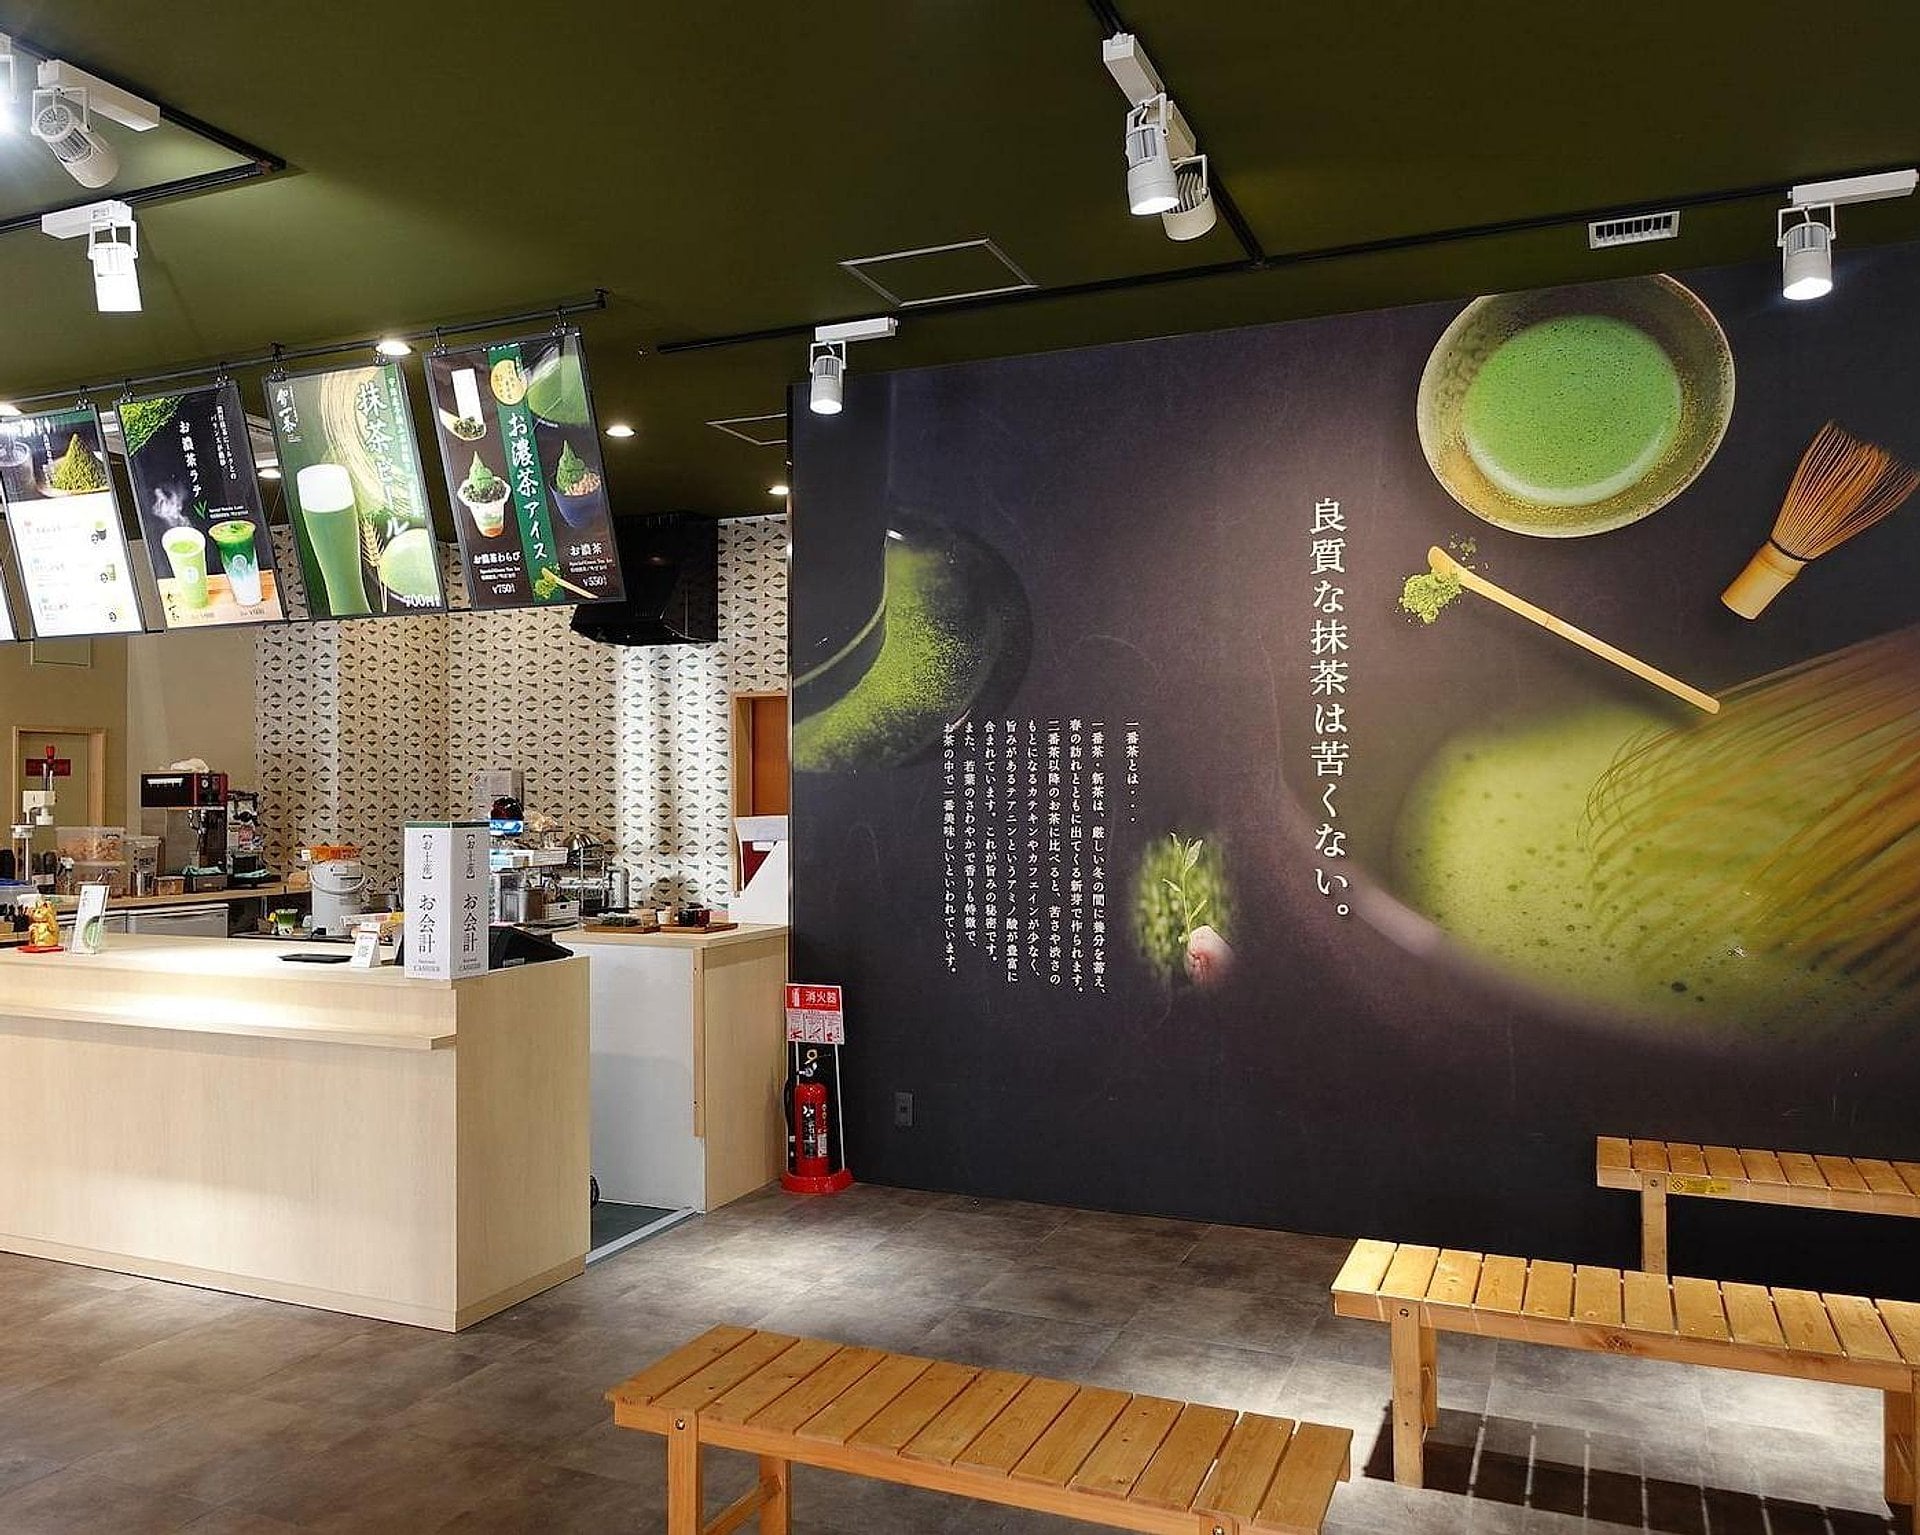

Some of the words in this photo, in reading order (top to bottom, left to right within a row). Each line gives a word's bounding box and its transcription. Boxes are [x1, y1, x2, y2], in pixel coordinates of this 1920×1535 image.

[508, 413, 547, 560] お濃茶アイス
[1309, 497, 1349, 916] 良質な抹茶は苦くない。
[418, 894, 436, 954] お会計
[463, 893, 478, 953] お会計
[805, 990, 837, 1004] 消火器
